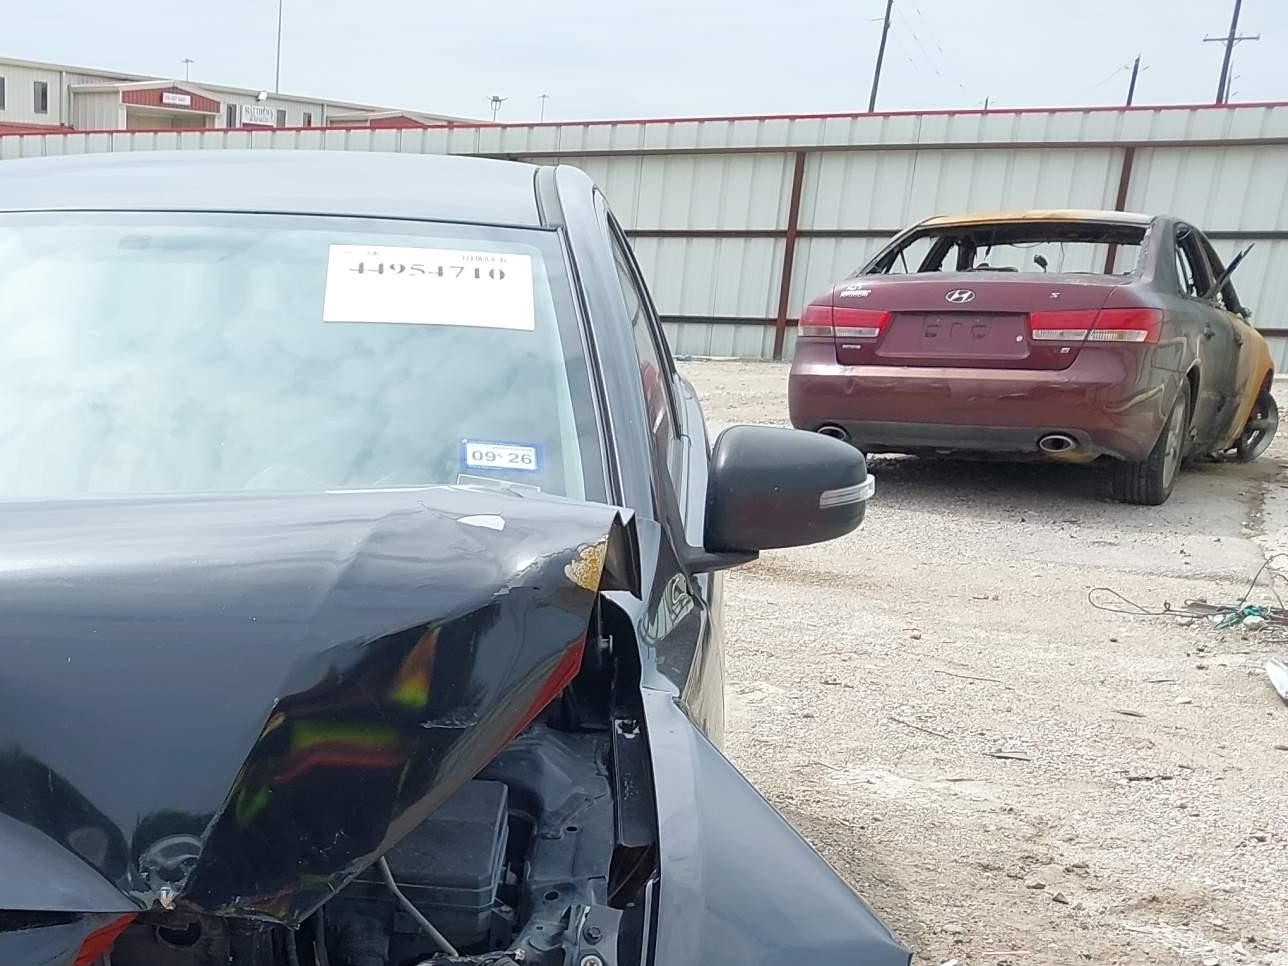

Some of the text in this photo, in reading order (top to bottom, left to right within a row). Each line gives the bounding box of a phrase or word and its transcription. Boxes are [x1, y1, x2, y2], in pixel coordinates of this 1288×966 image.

[349, 261, 506, 280] 44954710
[472, 450, 532, 465] 09 26
